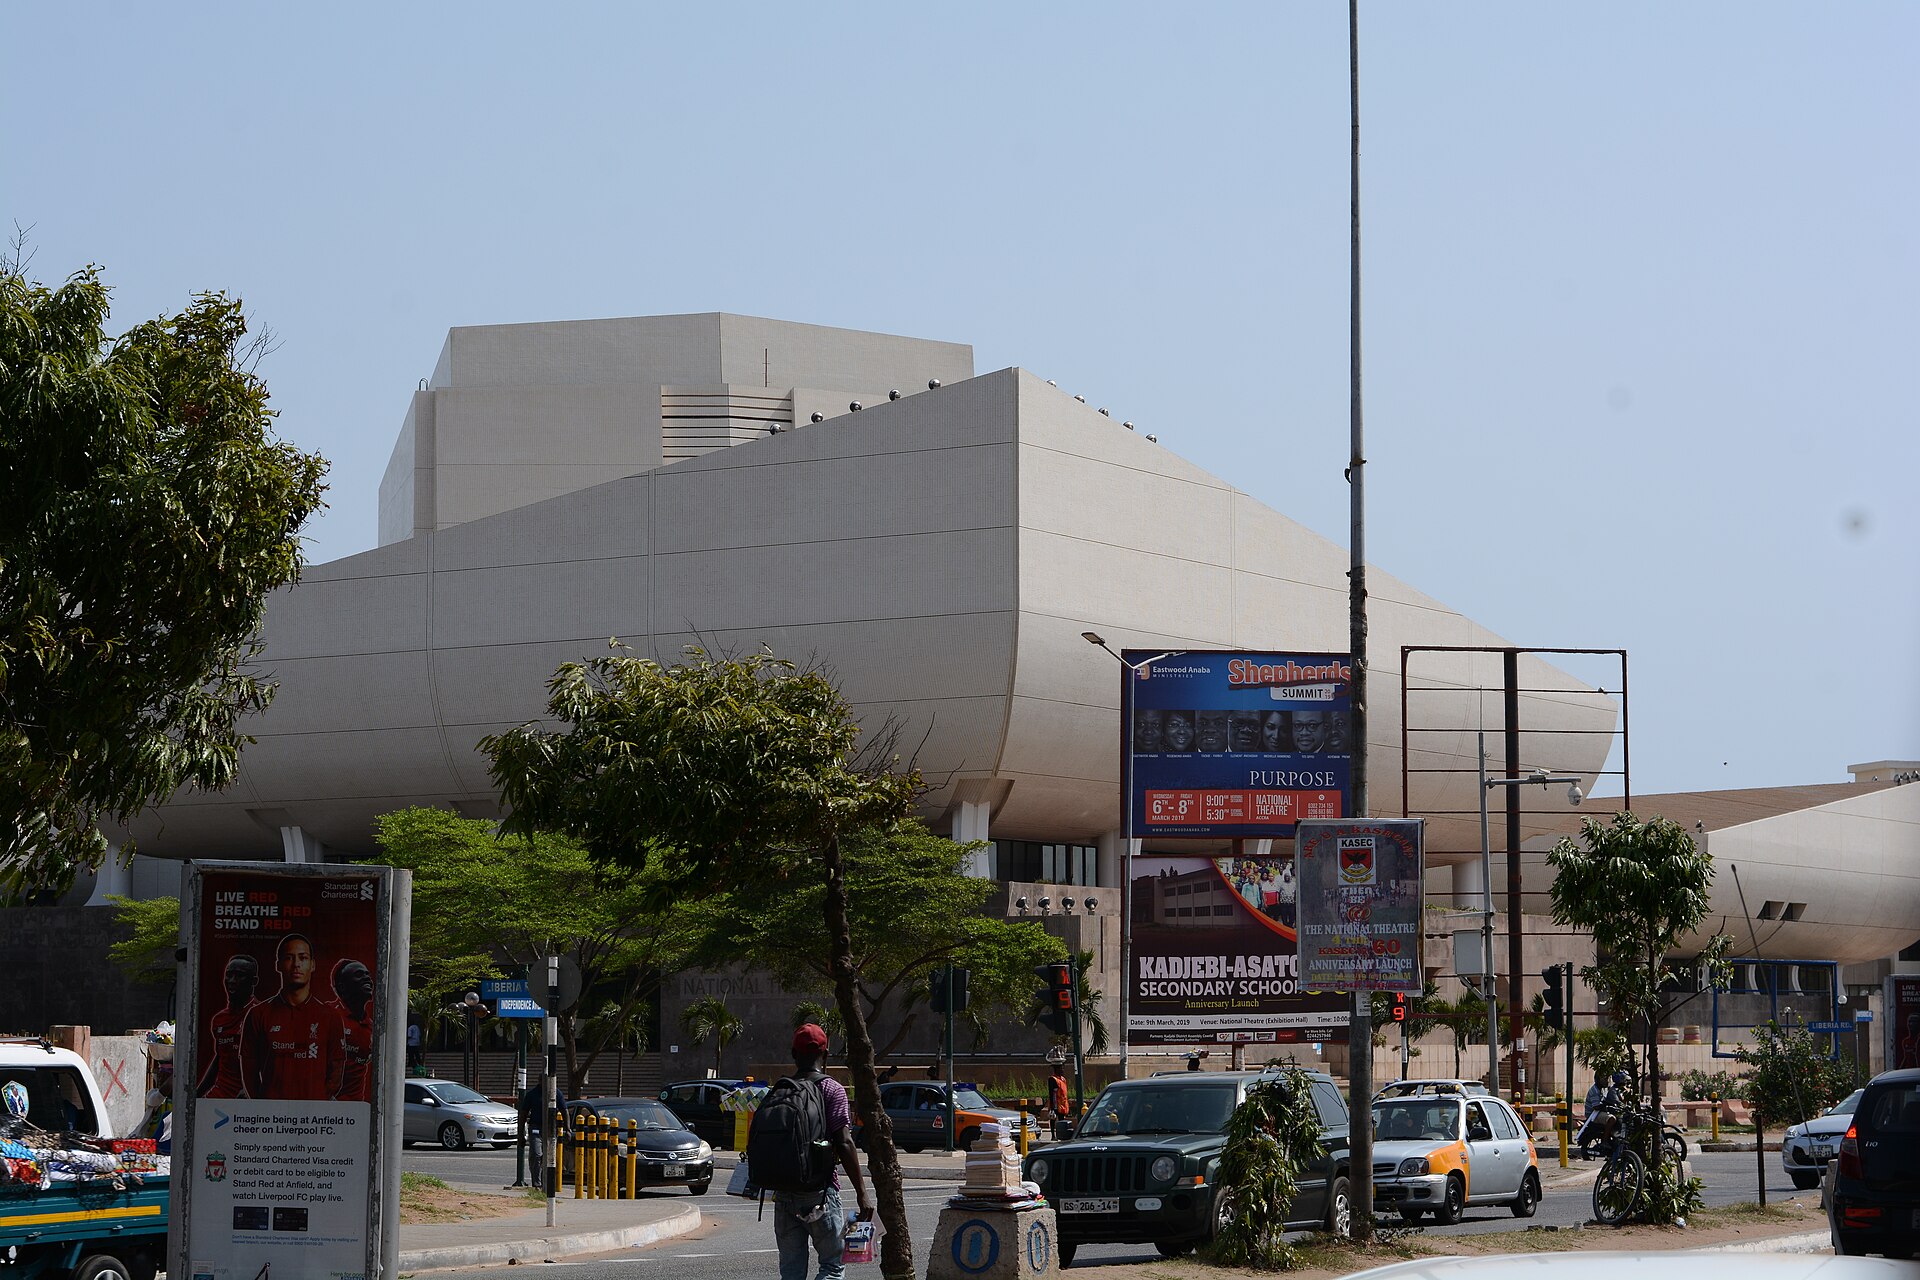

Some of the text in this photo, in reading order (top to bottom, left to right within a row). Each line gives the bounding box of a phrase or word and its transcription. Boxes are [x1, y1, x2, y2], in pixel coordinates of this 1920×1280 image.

[1189, 666, 1211, 674] Anaba
[1228, 659, 1350, 688] Shepherds
[1283, 689, 1323, 698] SUMMIT
[1250, 771, 1335, 787] PURPOSE
[1256, 795, 1292, 806] NATIONAL
[1256, 804, 1288, 816] THEATRE
[1341, 839, 1373, 847] KASEC
[324, 882, 358, 890] Standard
[216, 892, 278, 903] LIVE RED
[321, 890, 358, 899] Chartered
[1349, 896, 1365, 904] BE
[215, 906, 312, 917] BREATHE RED
[215, 919, 292, 930] STAND RED
[1305, 924, 1416, 935] THE NATIONAL THEATRE
[1373, 939, 1401, 956] 60
[1309, 959, 1412, 970] ANNIVERSARY LAUNCH
[487, 982, 523, 992] LIBERIA
[684, 978, 759, 995] NATIONAL
[1140, 981, 1235, 997] SECONDARY
[501, 1000, 532, 1010] INDEPENDENCE
[1059, 991, 1071, 1009] 9
[1184, 998, 1260, 1010] Anniversary Launch
[1394, 1007, 1405, 1021] 9
[1265, 1017, 1294, 1025] (Exhibition
[272, 1042, 295, 1050] Stand
[233, 1114, 356, 1127] Imagine being at Anfield to
[233, 1125, 259, 1134] cheer
[276, 1126, 318, 1138] Liverpool
[320, 1126, 336, 1135] FC.
[233, 1143, 326, 1155] Simply spend with your
[233, 1155, 354, 1165] Standard Chartered Visa credit
[244, 1168, 263, 1176] debit
[265, 1168, 284, 1176] card
[286, 1168, 294, 1176] to
[295, 1168, 306, 1176] be
[308, 1168, 336, 1180] eligible
[338, 1170, 346, 1178] to
[232, 1180, 333, 1190] Stand Red at Anfield, and
[232, 1192, 344, 1205] watch Liverpool FC play live.
[1064, 1202, 1074, 1211] GS
